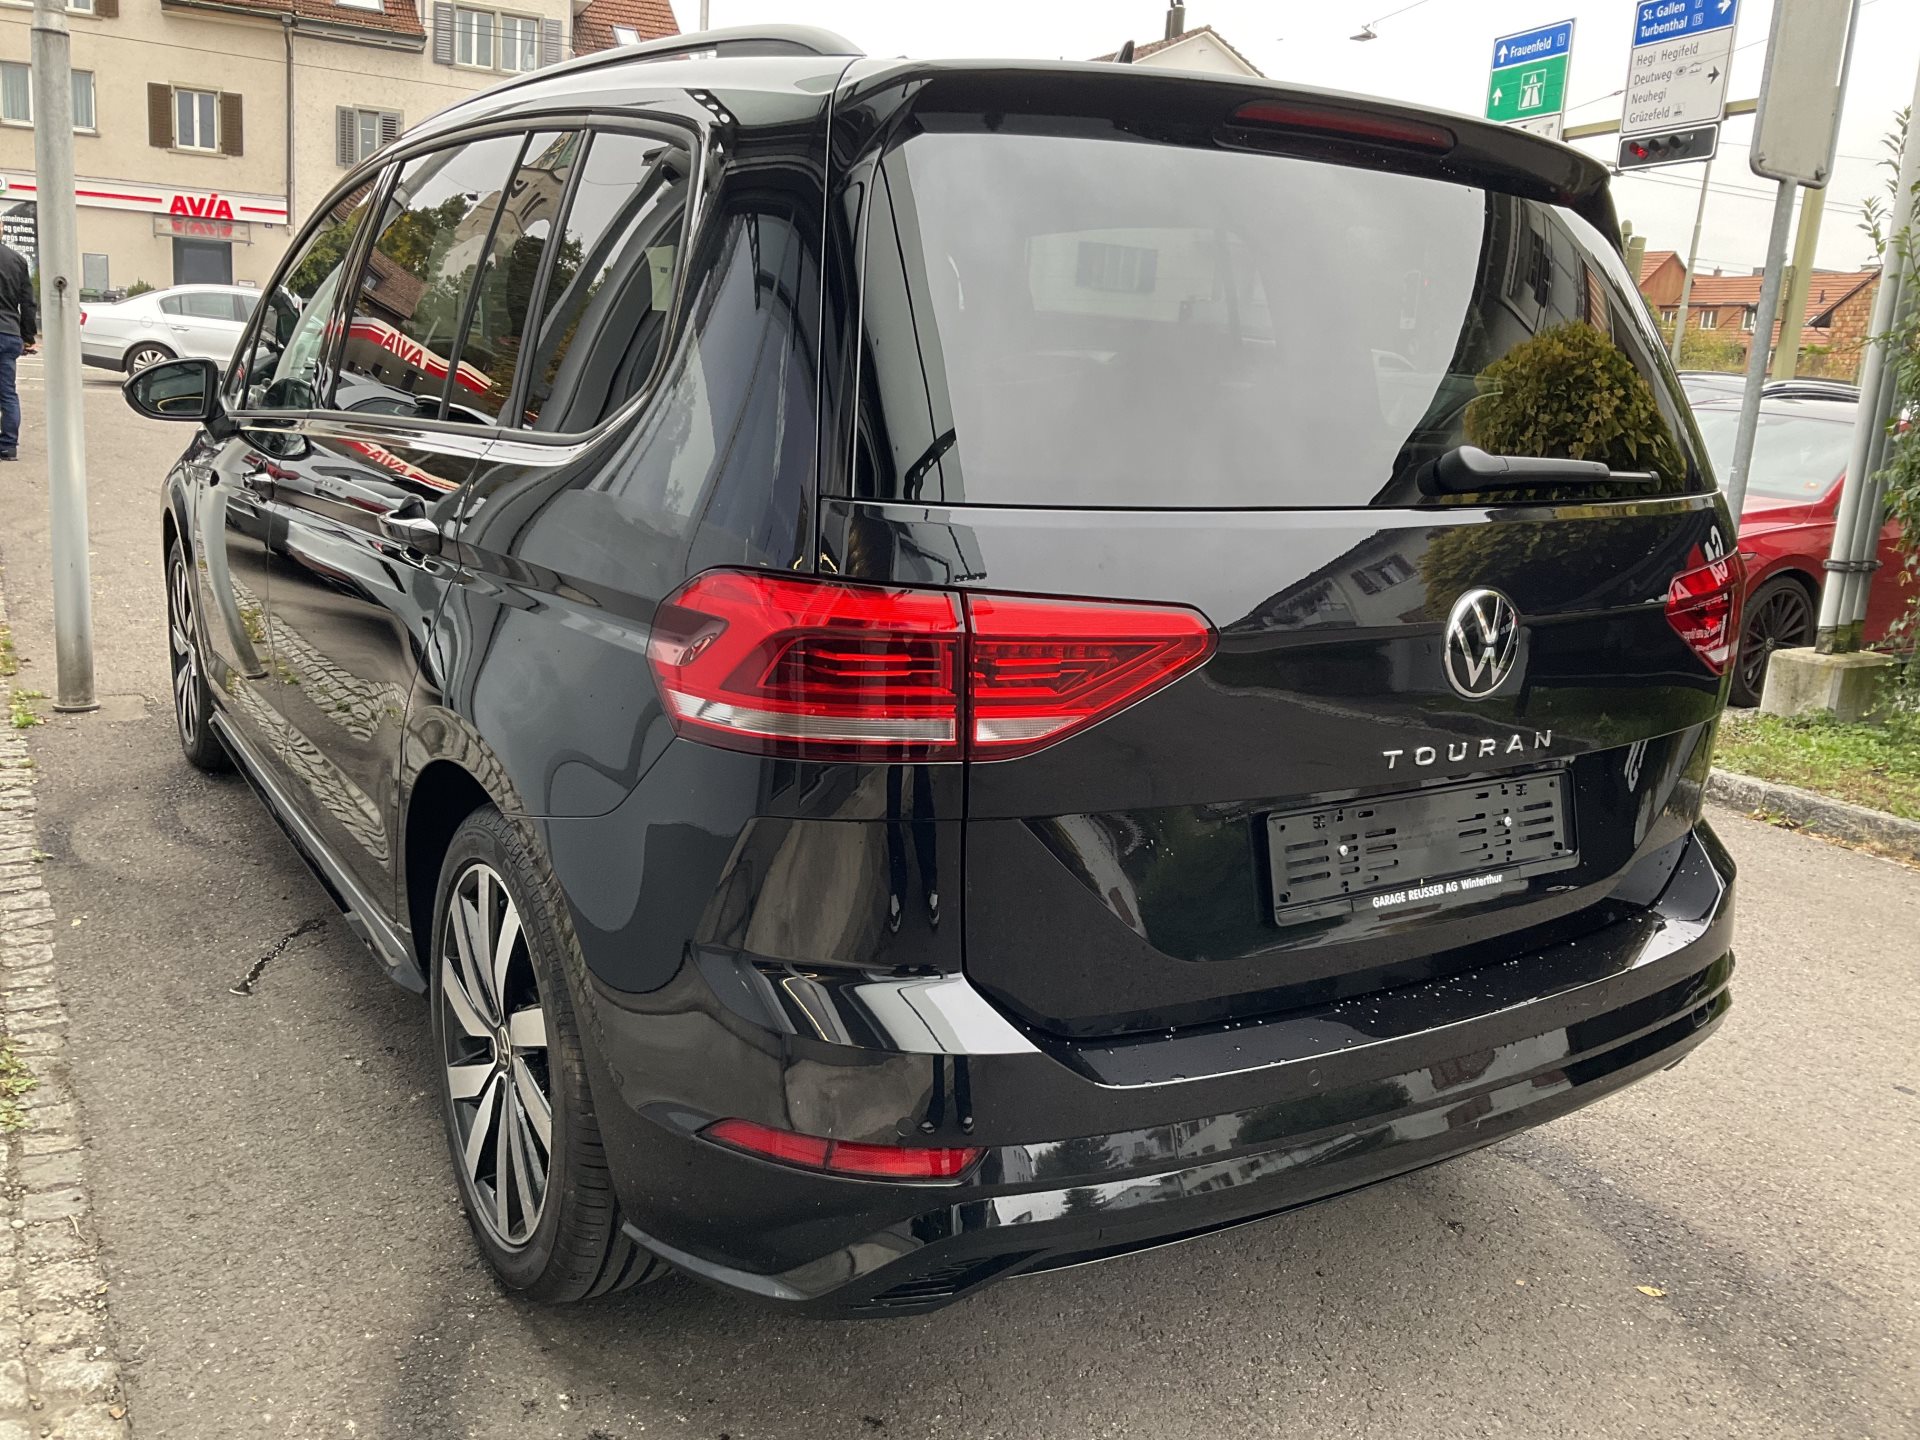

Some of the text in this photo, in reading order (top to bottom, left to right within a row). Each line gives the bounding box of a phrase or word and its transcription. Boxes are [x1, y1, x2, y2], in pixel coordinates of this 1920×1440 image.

[1643, 9, 1654, 21] St.
[1657, 3, 1685, 17] Gallen
[1641, 16, 1688, 38] Turbenthal
[1510, 36, 1552, 57] Frauenfeld
[1636, 42, 1699, 67] Hegi Hegifeld
[1634, 70, 1672, 86] Deutweg
[1631, 88, 1667, 105] Neuhegi
[1629, 106, 1670, 124] Grüzefeld
[13, 225, 35, 234] gehen,
[1383, 730, 1552, 769] TOURAN
[1372, 873, 1503, 908] GARAGE REUSSER AG Winterthur
